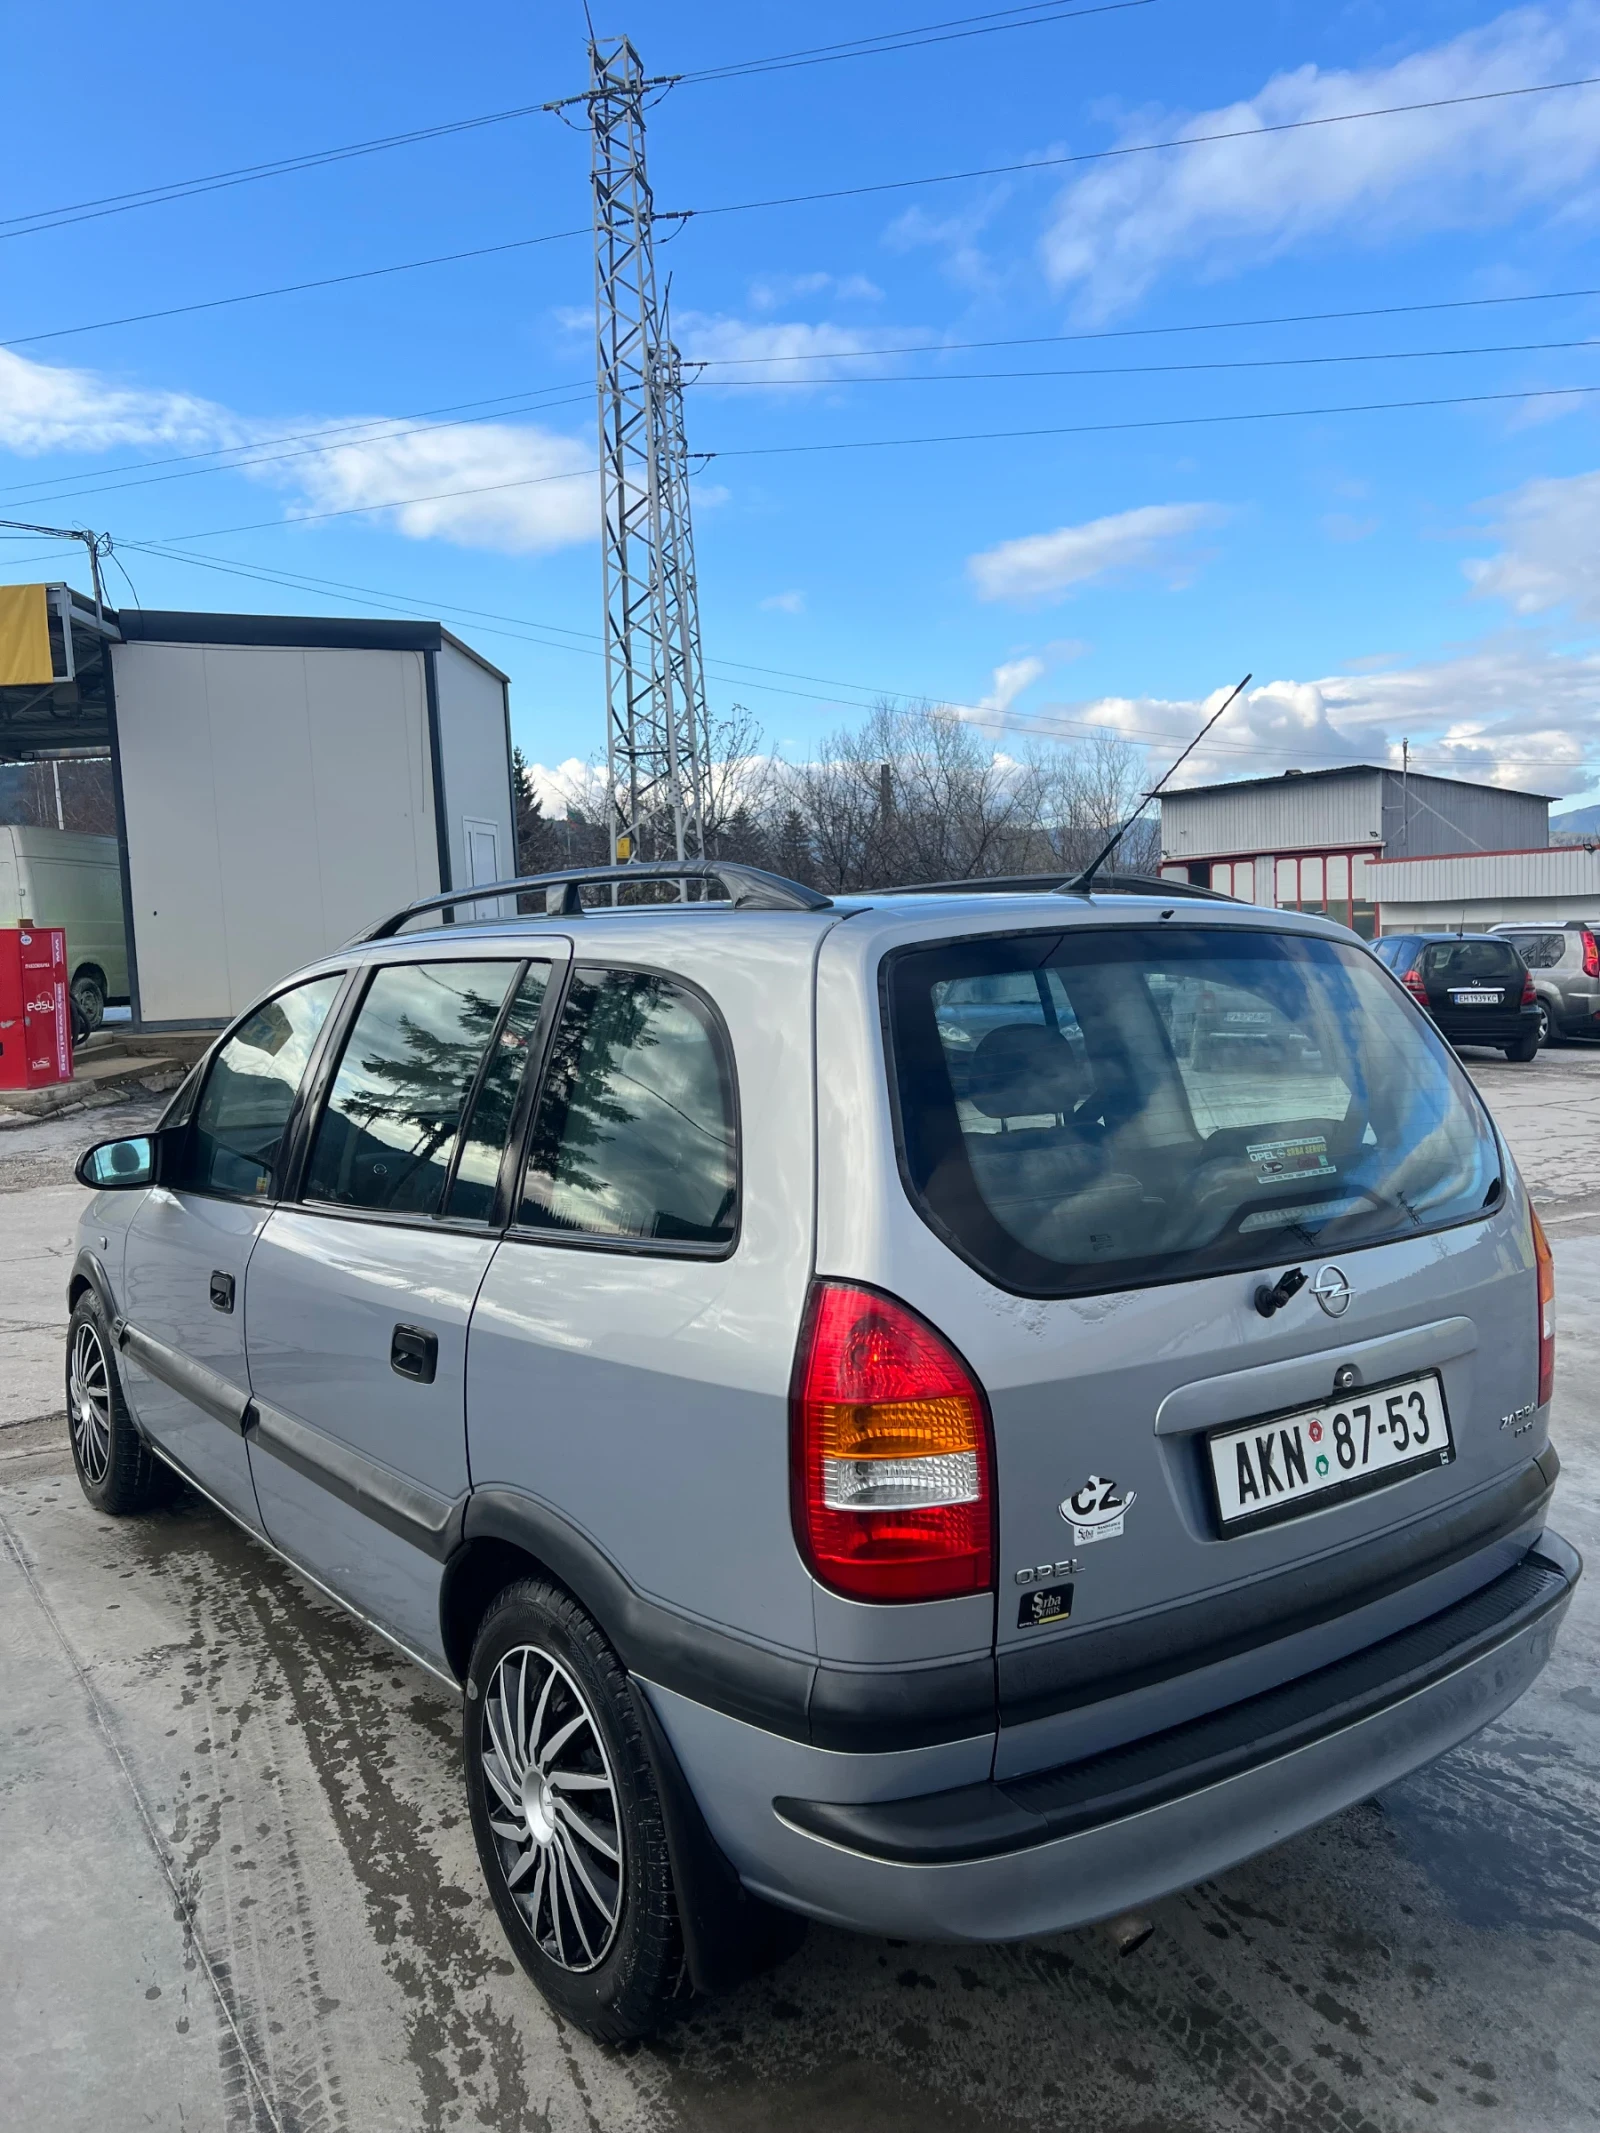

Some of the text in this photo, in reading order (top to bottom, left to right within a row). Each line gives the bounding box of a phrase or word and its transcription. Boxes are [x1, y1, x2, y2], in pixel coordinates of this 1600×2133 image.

[27, 1000, 55, 1012] easy
[1249, 1151, 1278, 1161] OPEL
[1235, 1391, 1430, 1505] AKN 87-53
[1071, 1477, 1123, 1515] CZ
[1015, 1558, 1086, 1585] OPEL
[1033, 1591, 1061, 1608] Srba
